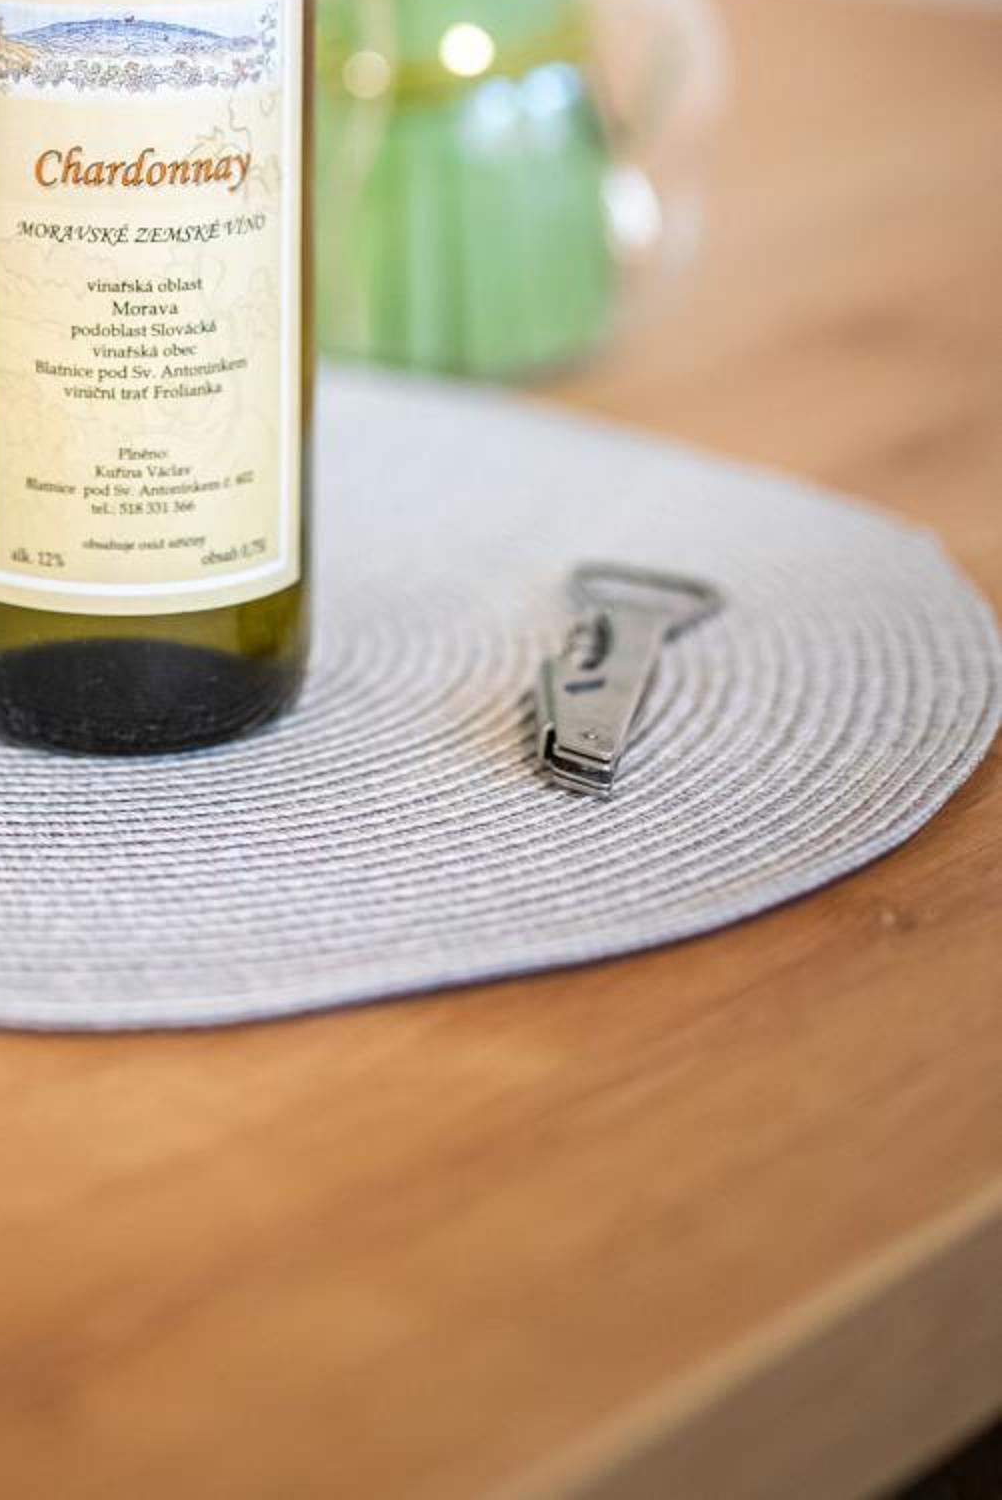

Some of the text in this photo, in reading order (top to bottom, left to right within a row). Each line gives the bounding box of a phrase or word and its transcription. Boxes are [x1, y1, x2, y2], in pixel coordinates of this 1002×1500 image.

[34, 147, 251, 192] Chardonnay
[158, 278, 203, 292] oblast
[111, 301, 179, 317] Morava
[71, 324, 147, 339] podoblast
[163, 344, 197, 357] obec
[35, 359, 94, 379] Blatnice
[98, 366, 128, 382] pod
